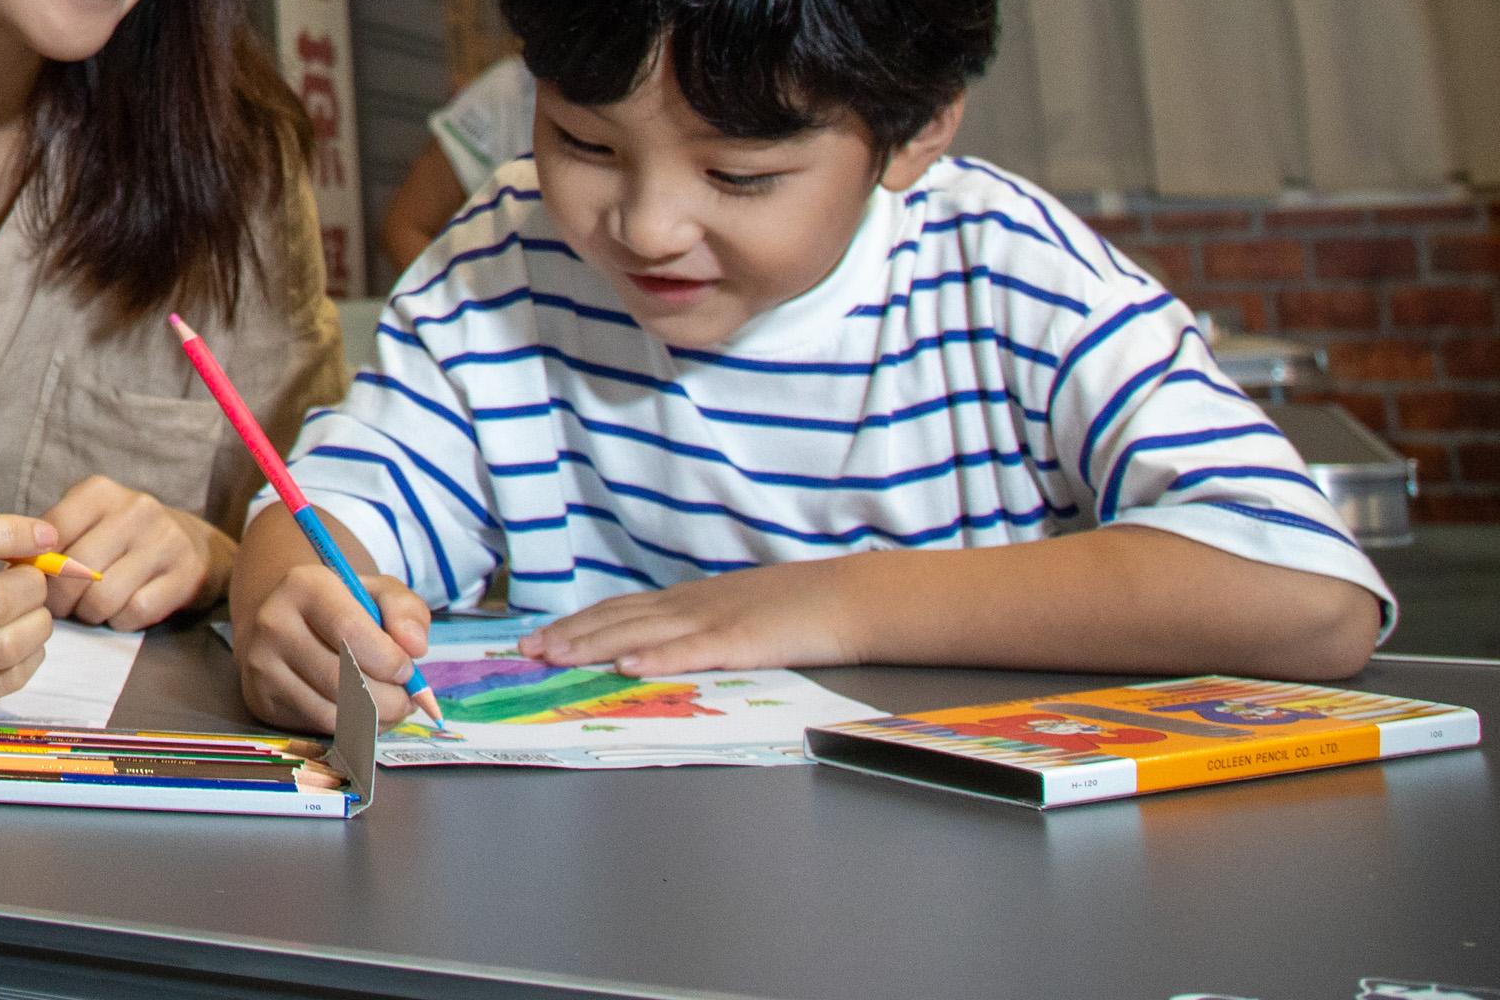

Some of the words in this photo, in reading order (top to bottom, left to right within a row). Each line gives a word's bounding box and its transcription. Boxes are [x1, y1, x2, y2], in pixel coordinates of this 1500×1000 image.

[1206, 754, 1252, 771] COLLEEN
[1255, 748, 1290, 763] PENCIL
[1071, 779, 1098, 790] H-120
